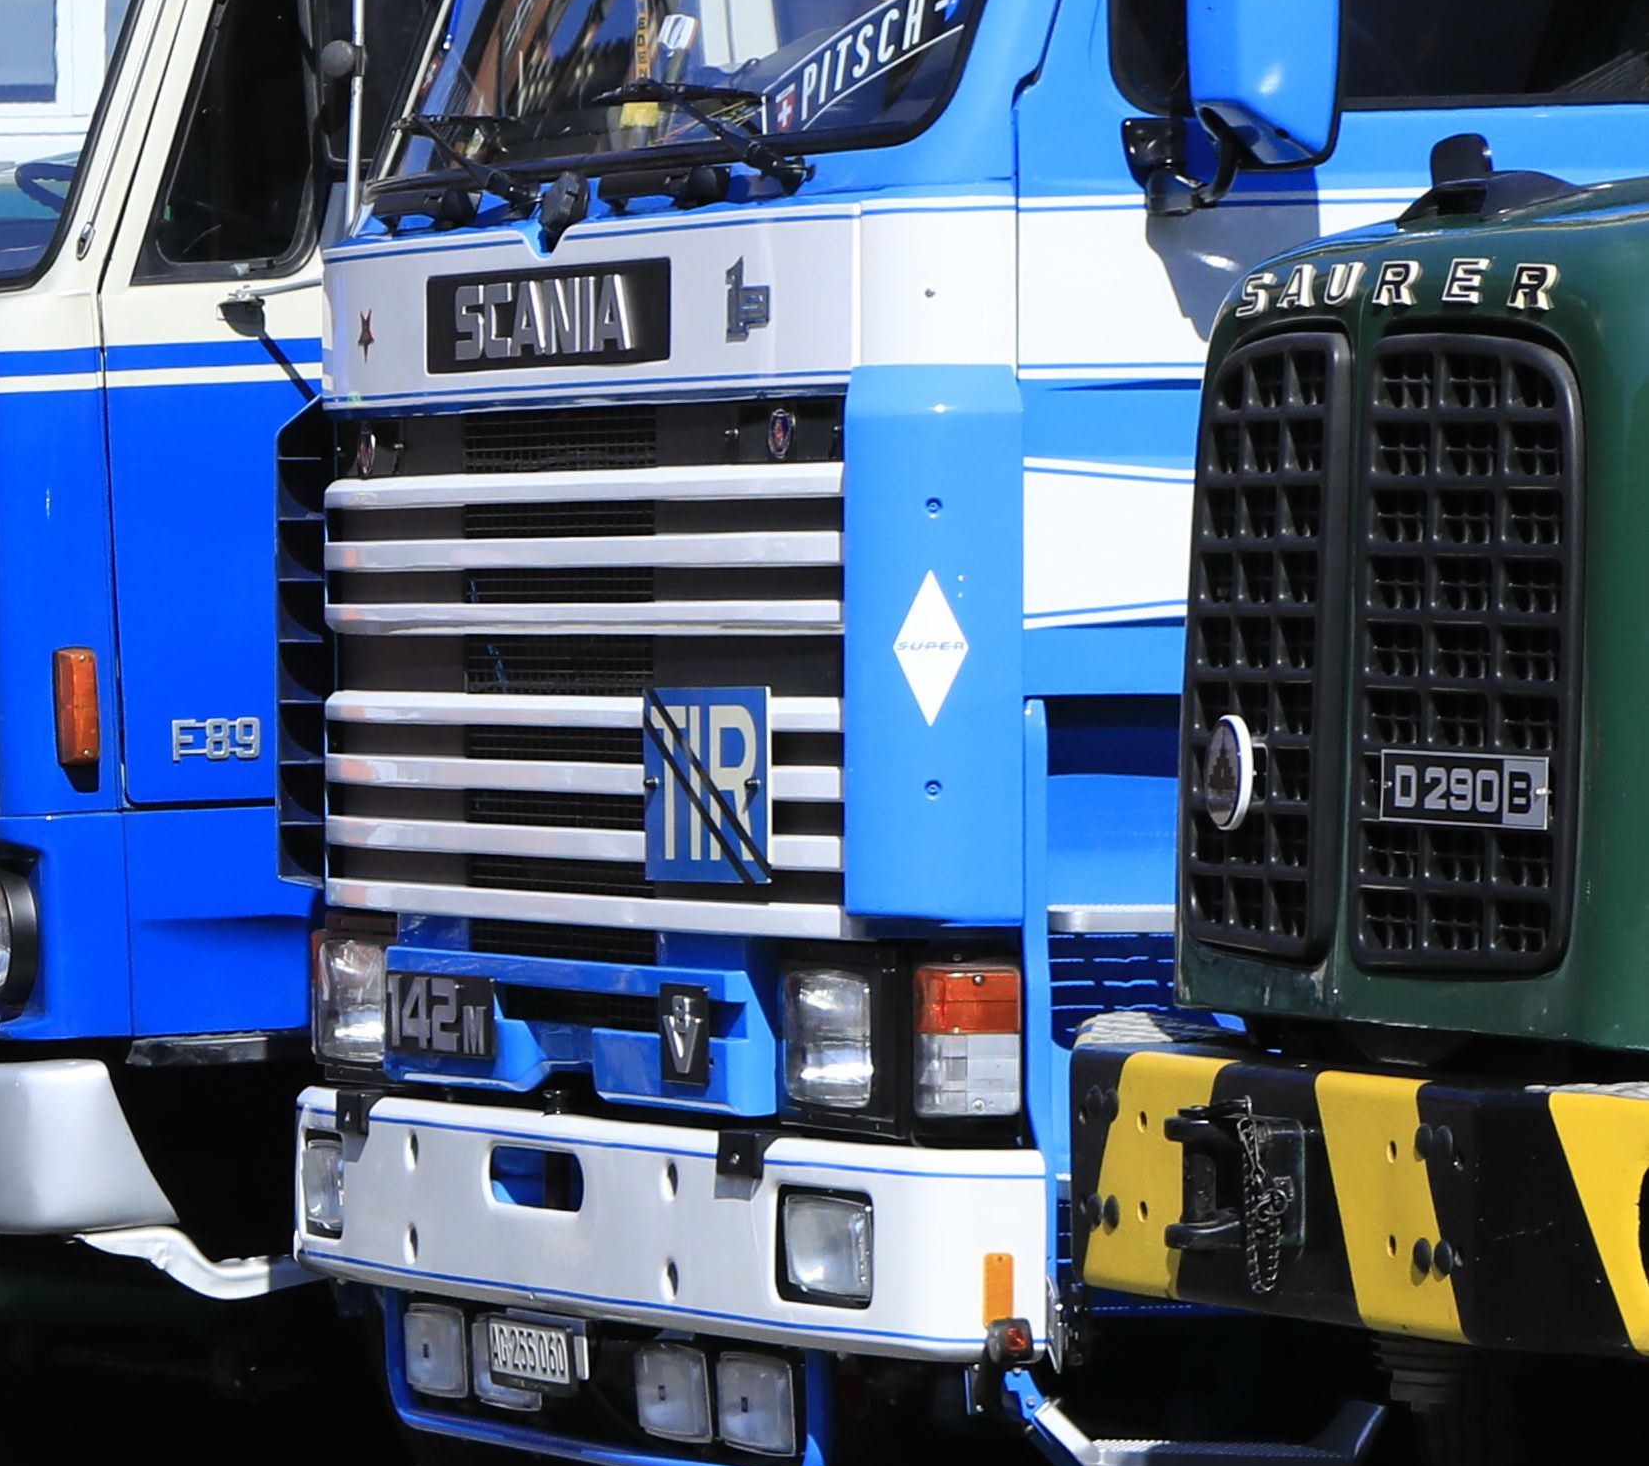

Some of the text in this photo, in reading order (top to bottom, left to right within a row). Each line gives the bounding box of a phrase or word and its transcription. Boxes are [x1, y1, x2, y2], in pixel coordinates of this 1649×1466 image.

[1235, 258, 1558, 318] SAURER
[455, 274, 633, 361] SCANIA
[896, 641, 965, 651] SUPER
[171, 717, 261, 762] F89
[650, 705, 757, 861] TIR
[509, 1328, 566, 1375] 255060
